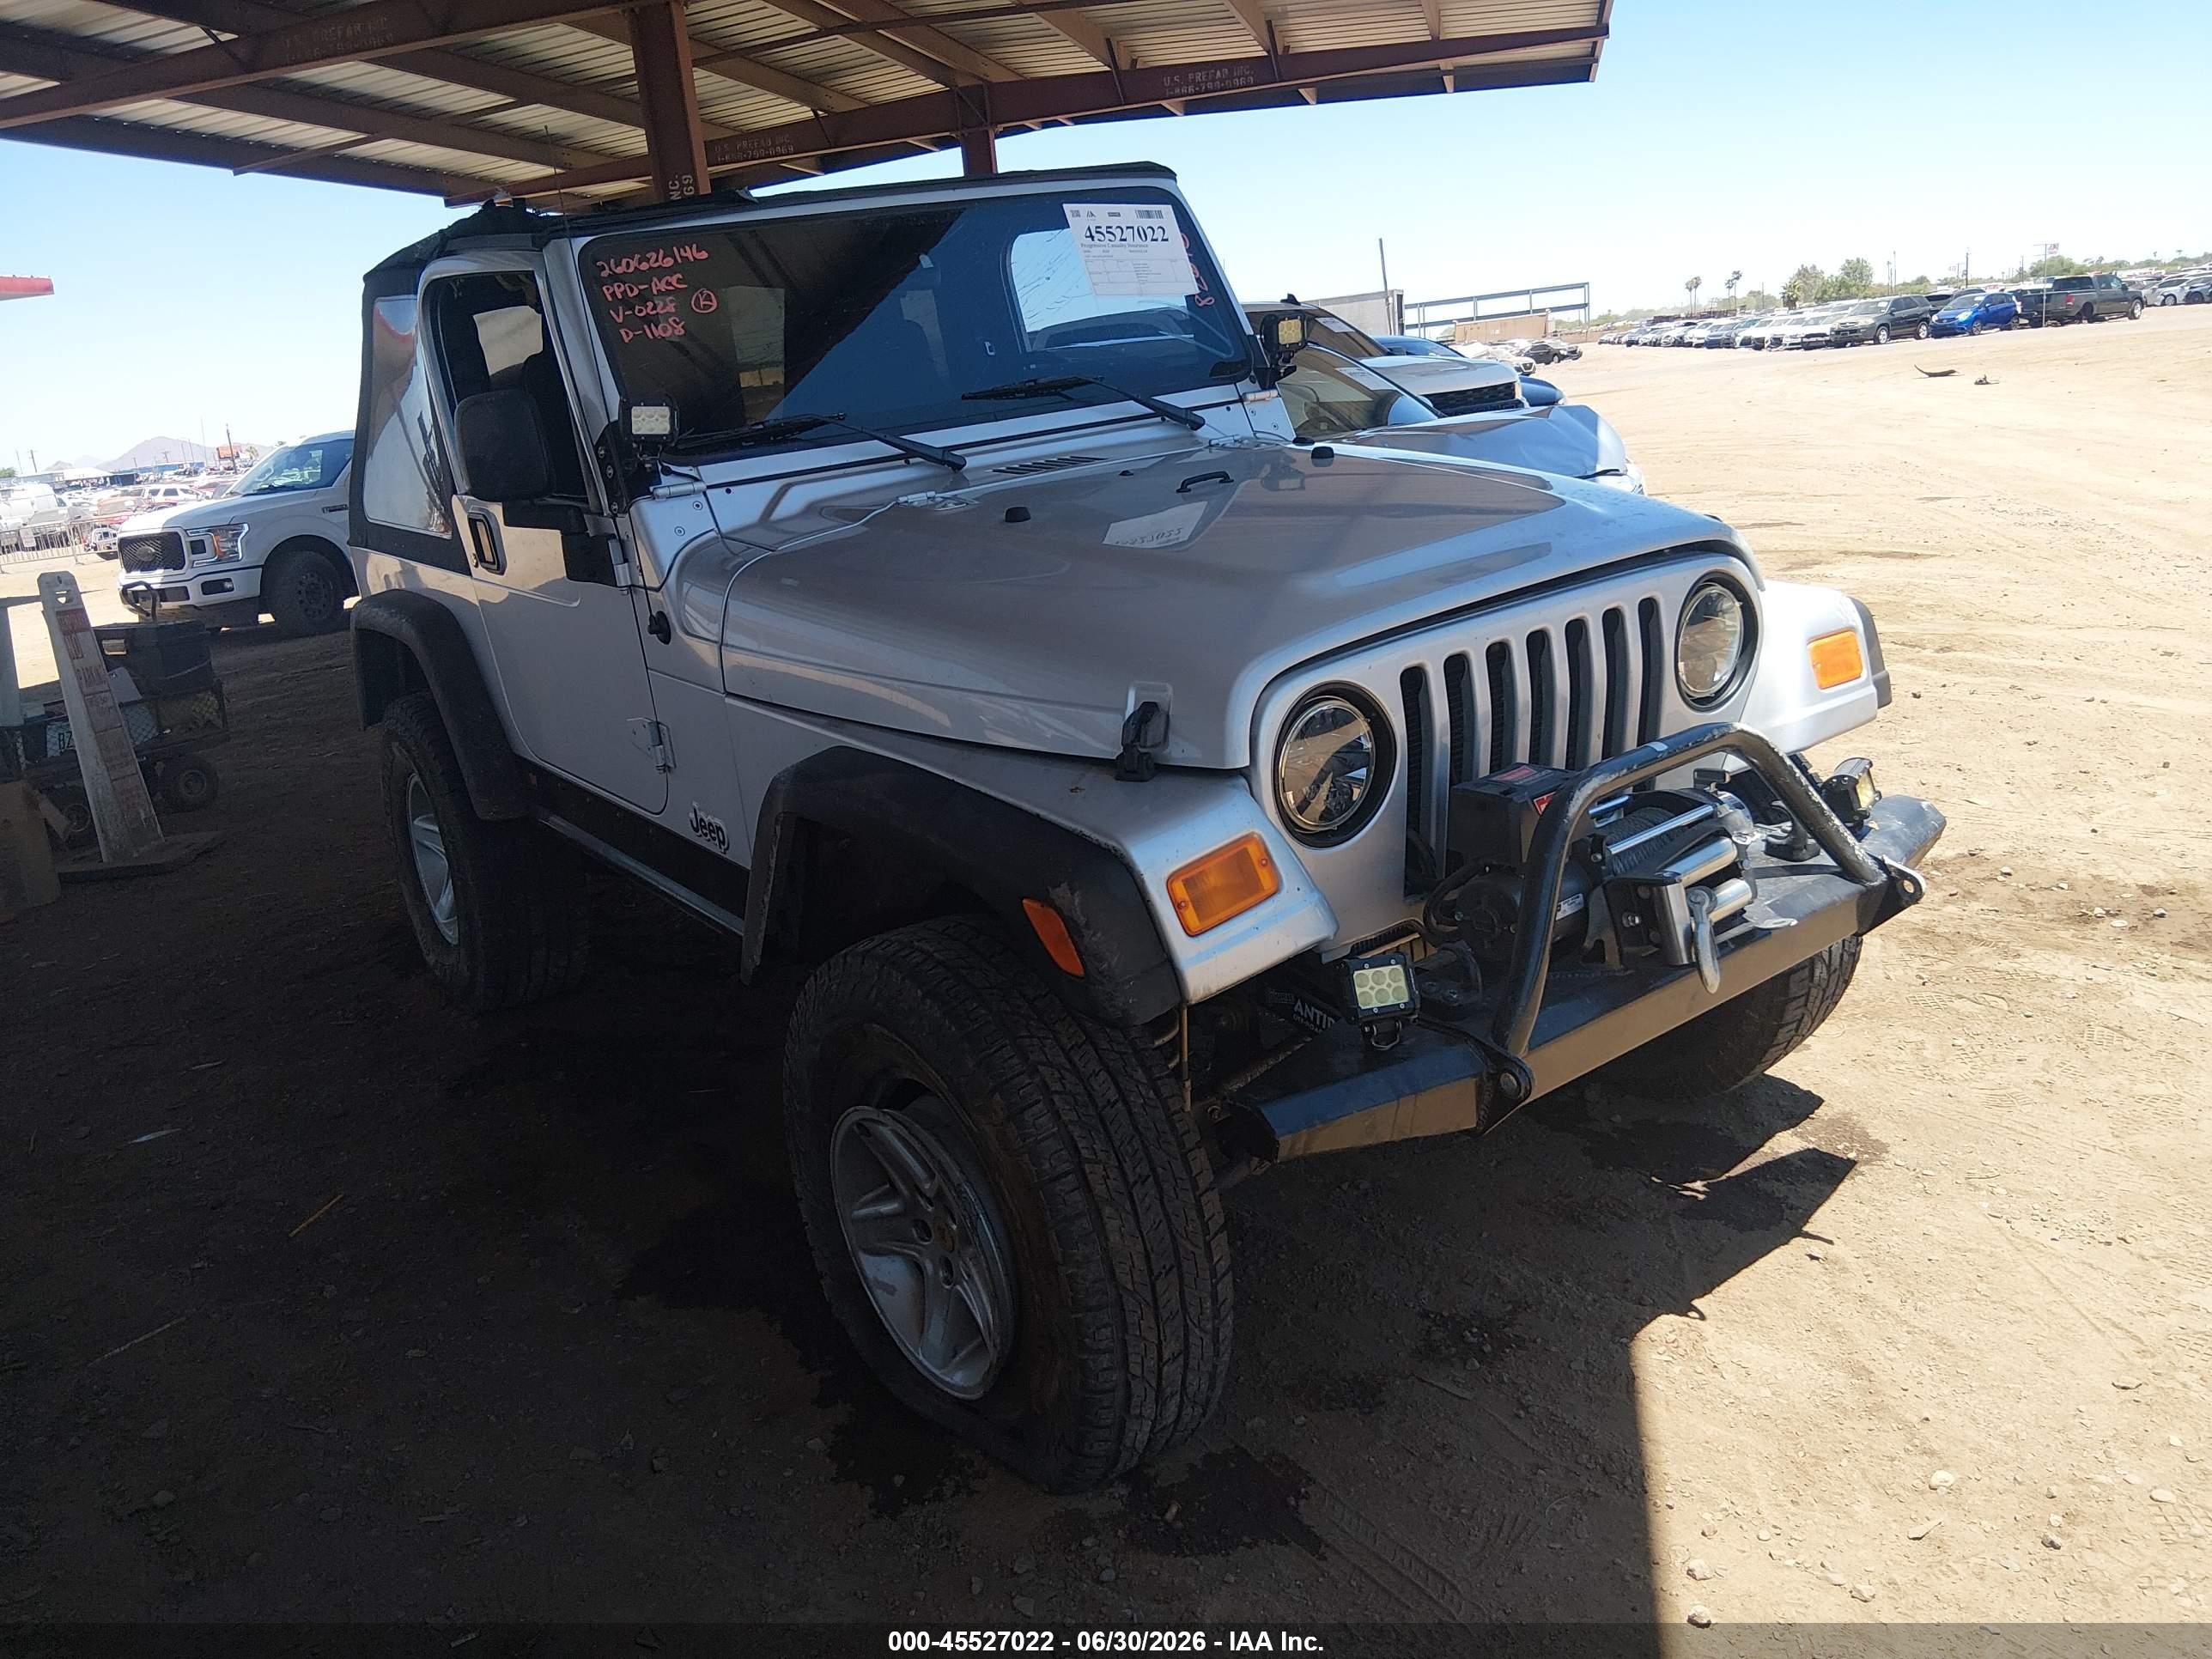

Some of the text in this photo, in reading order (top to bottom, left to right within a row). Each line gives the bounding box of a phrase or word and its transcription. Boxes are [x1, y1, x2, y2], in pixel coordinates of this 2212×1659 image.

[1188, 68, 1229, 83] PREFAB
[1085, 225, 1169, 242] 45527022
[596, 243, 708, 277] 260626146
[602, 273, 688, 302] PPD-ACC
[619, 316, 686, 343] D-1108
[690, 805, 728, 851] Jeep
